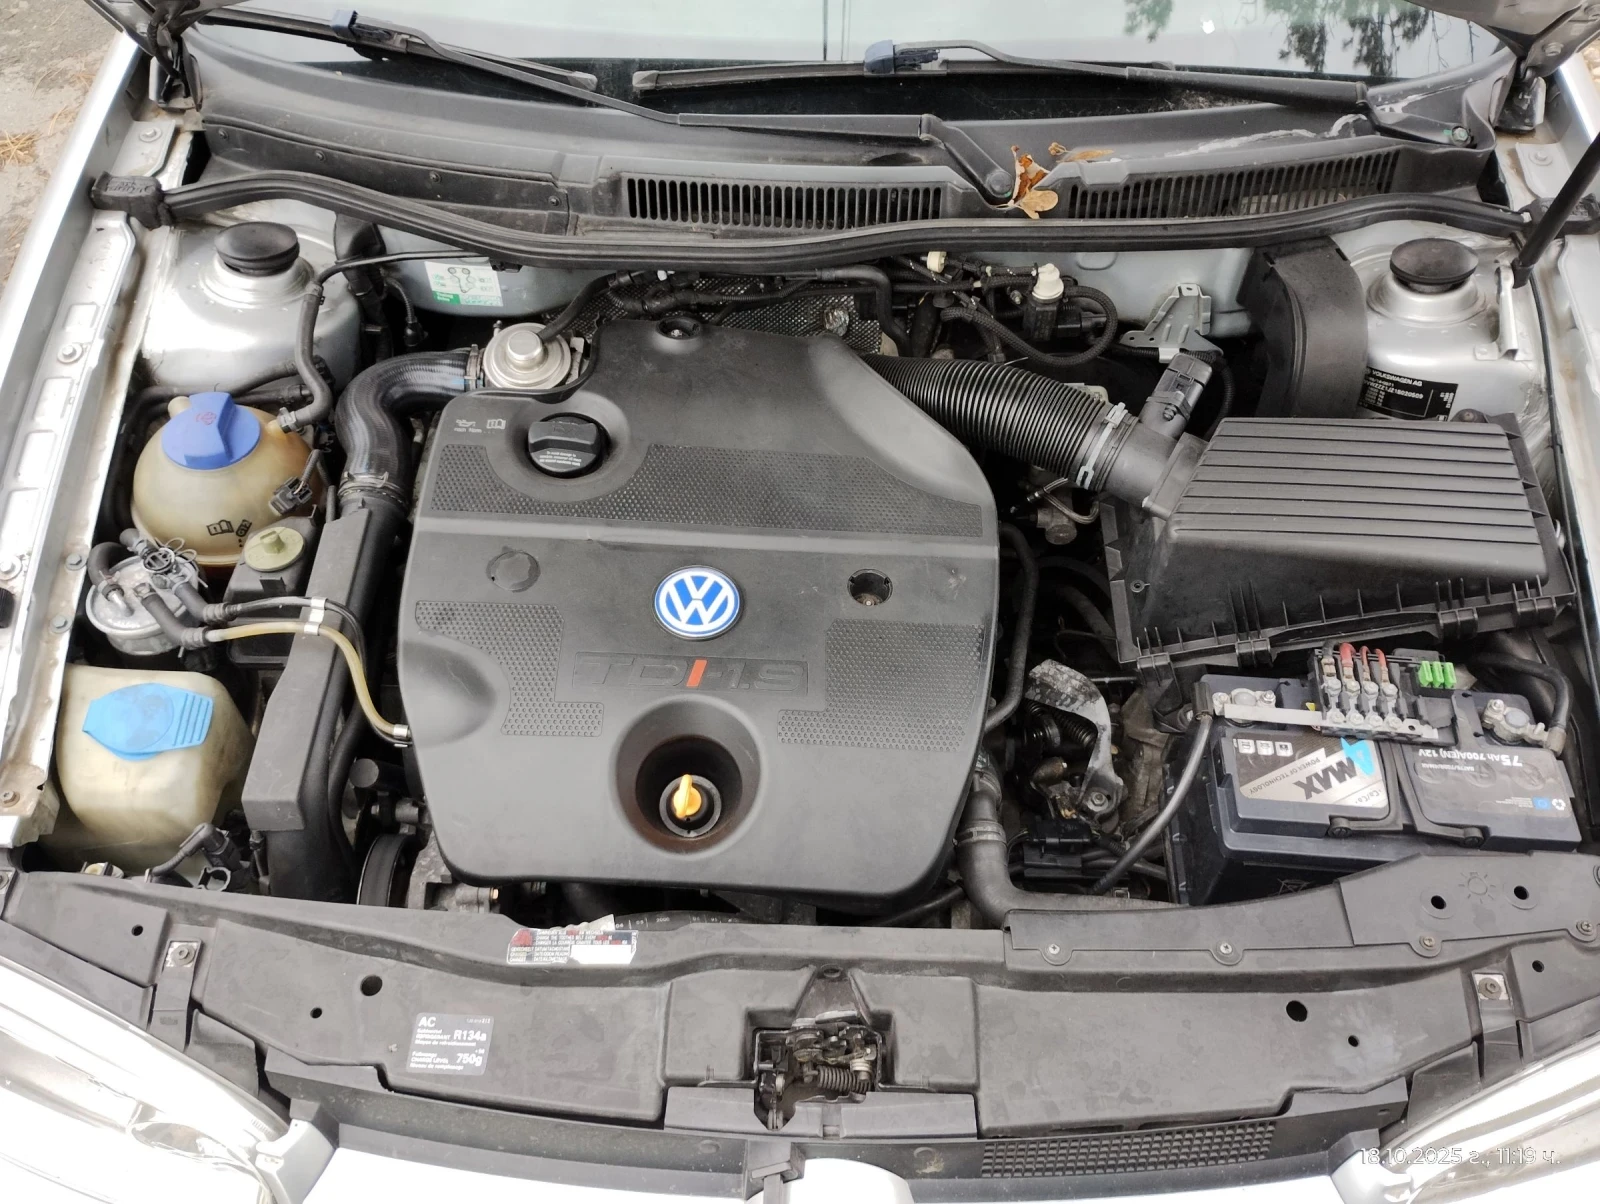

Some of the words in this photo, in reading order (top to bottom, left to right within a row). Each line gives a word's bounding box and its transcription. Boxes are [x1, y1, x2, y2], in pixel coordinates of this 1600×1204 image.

[1372, 370, 1413, 384] VOLKSWAGEN
[1299, 756, 1321, 771] POWER
[1290, 766, 1298, 776] OF
[1250, 770, 1290, 794] TECHNOLOGY
[418, 1016, 437, 1028] AC
[453, 1029, 487, 1042] R134a
[456, 1053, 483, 1067] 750g
